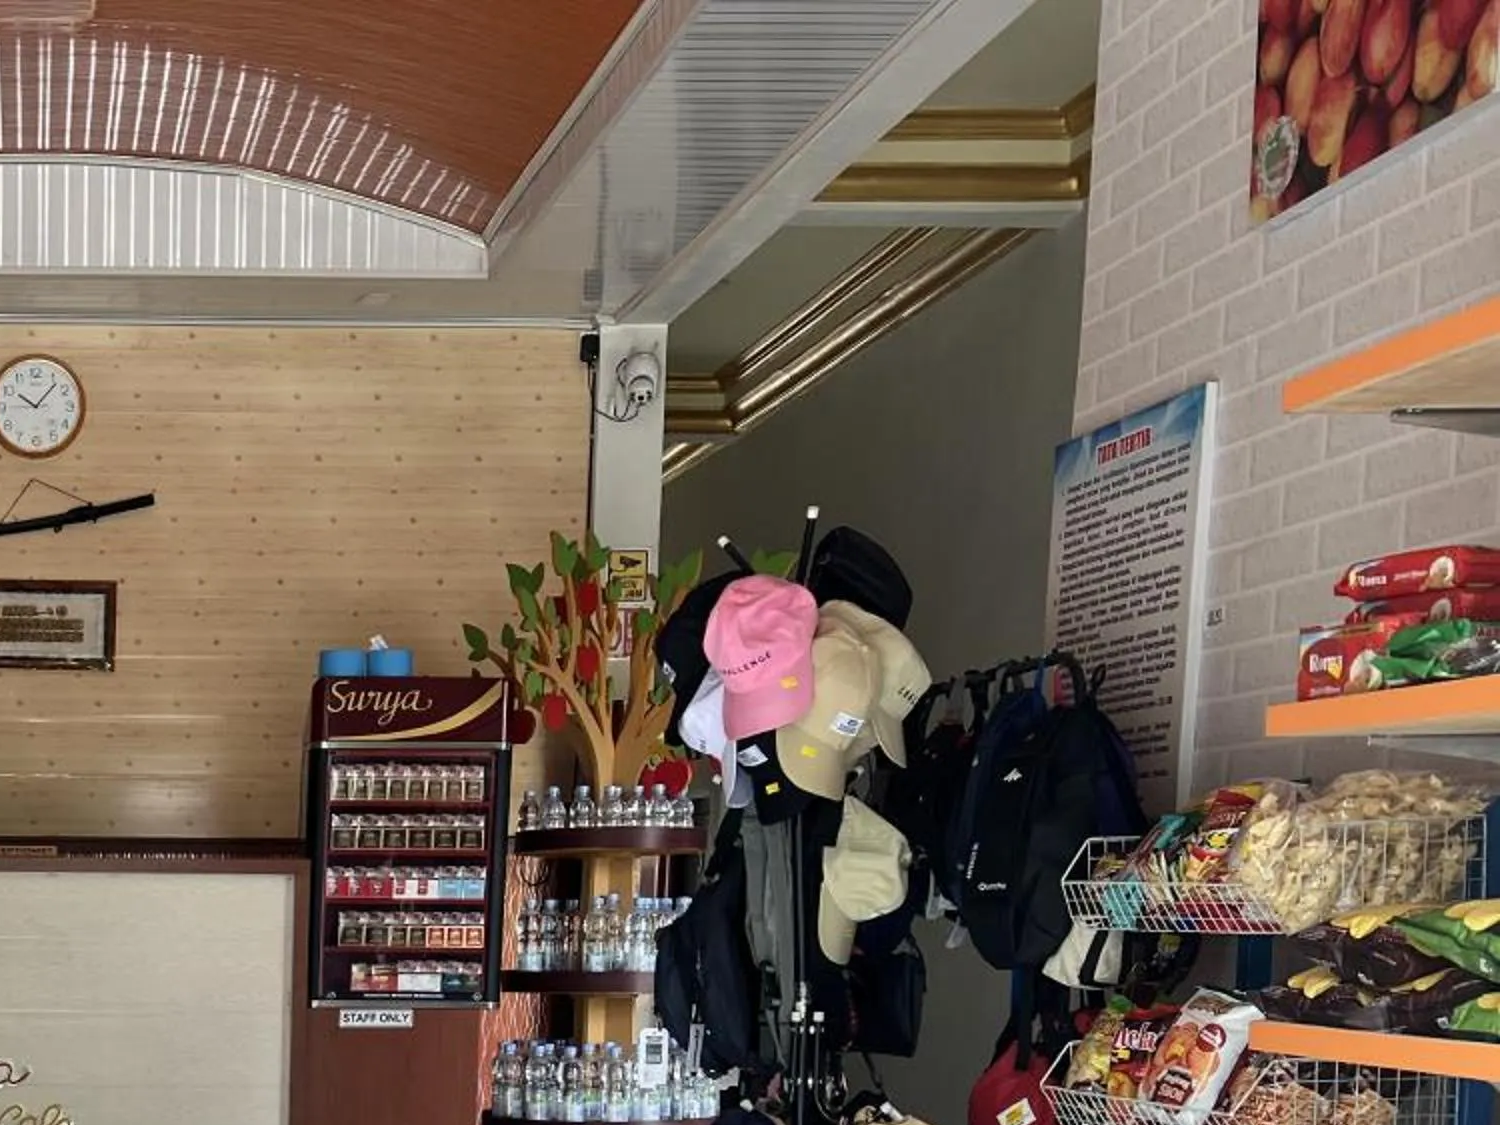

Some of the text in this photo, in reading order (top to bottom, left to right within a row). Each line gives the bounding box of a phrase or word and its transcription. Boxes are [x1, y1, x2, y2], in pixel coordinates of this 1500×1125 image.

[327, 679, 433, 727] Surya
[342, 1012, 410, 1024] STAFF ONLY
